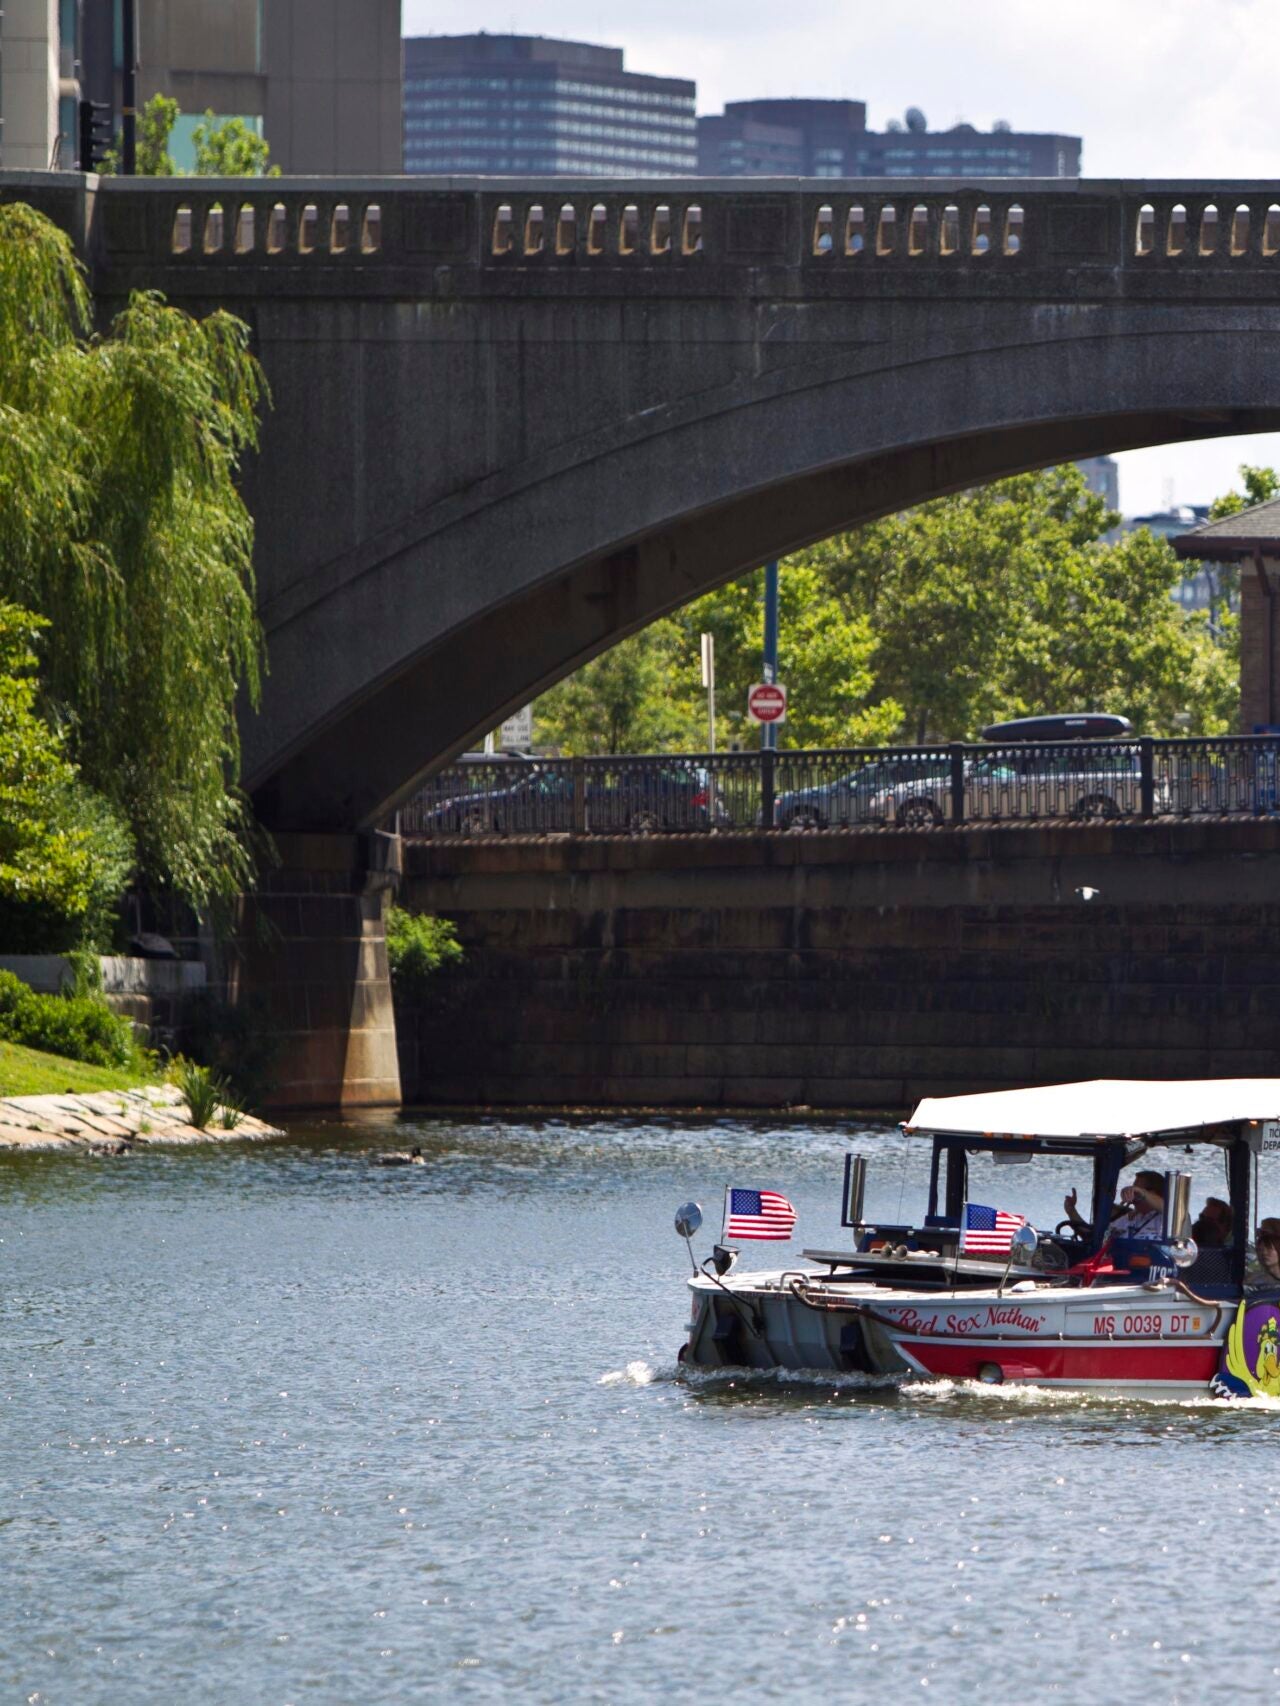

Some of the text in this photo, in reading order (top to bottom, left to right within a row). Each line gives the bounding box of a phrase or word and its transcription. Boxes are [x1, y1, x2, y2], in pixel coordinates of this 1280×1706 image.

[944, 1314, 981, 1333] Sox
[984, 1306, 1046, 1333] Nathan"
[1094, 1315, 1190, 1334] MS 0039 DT
